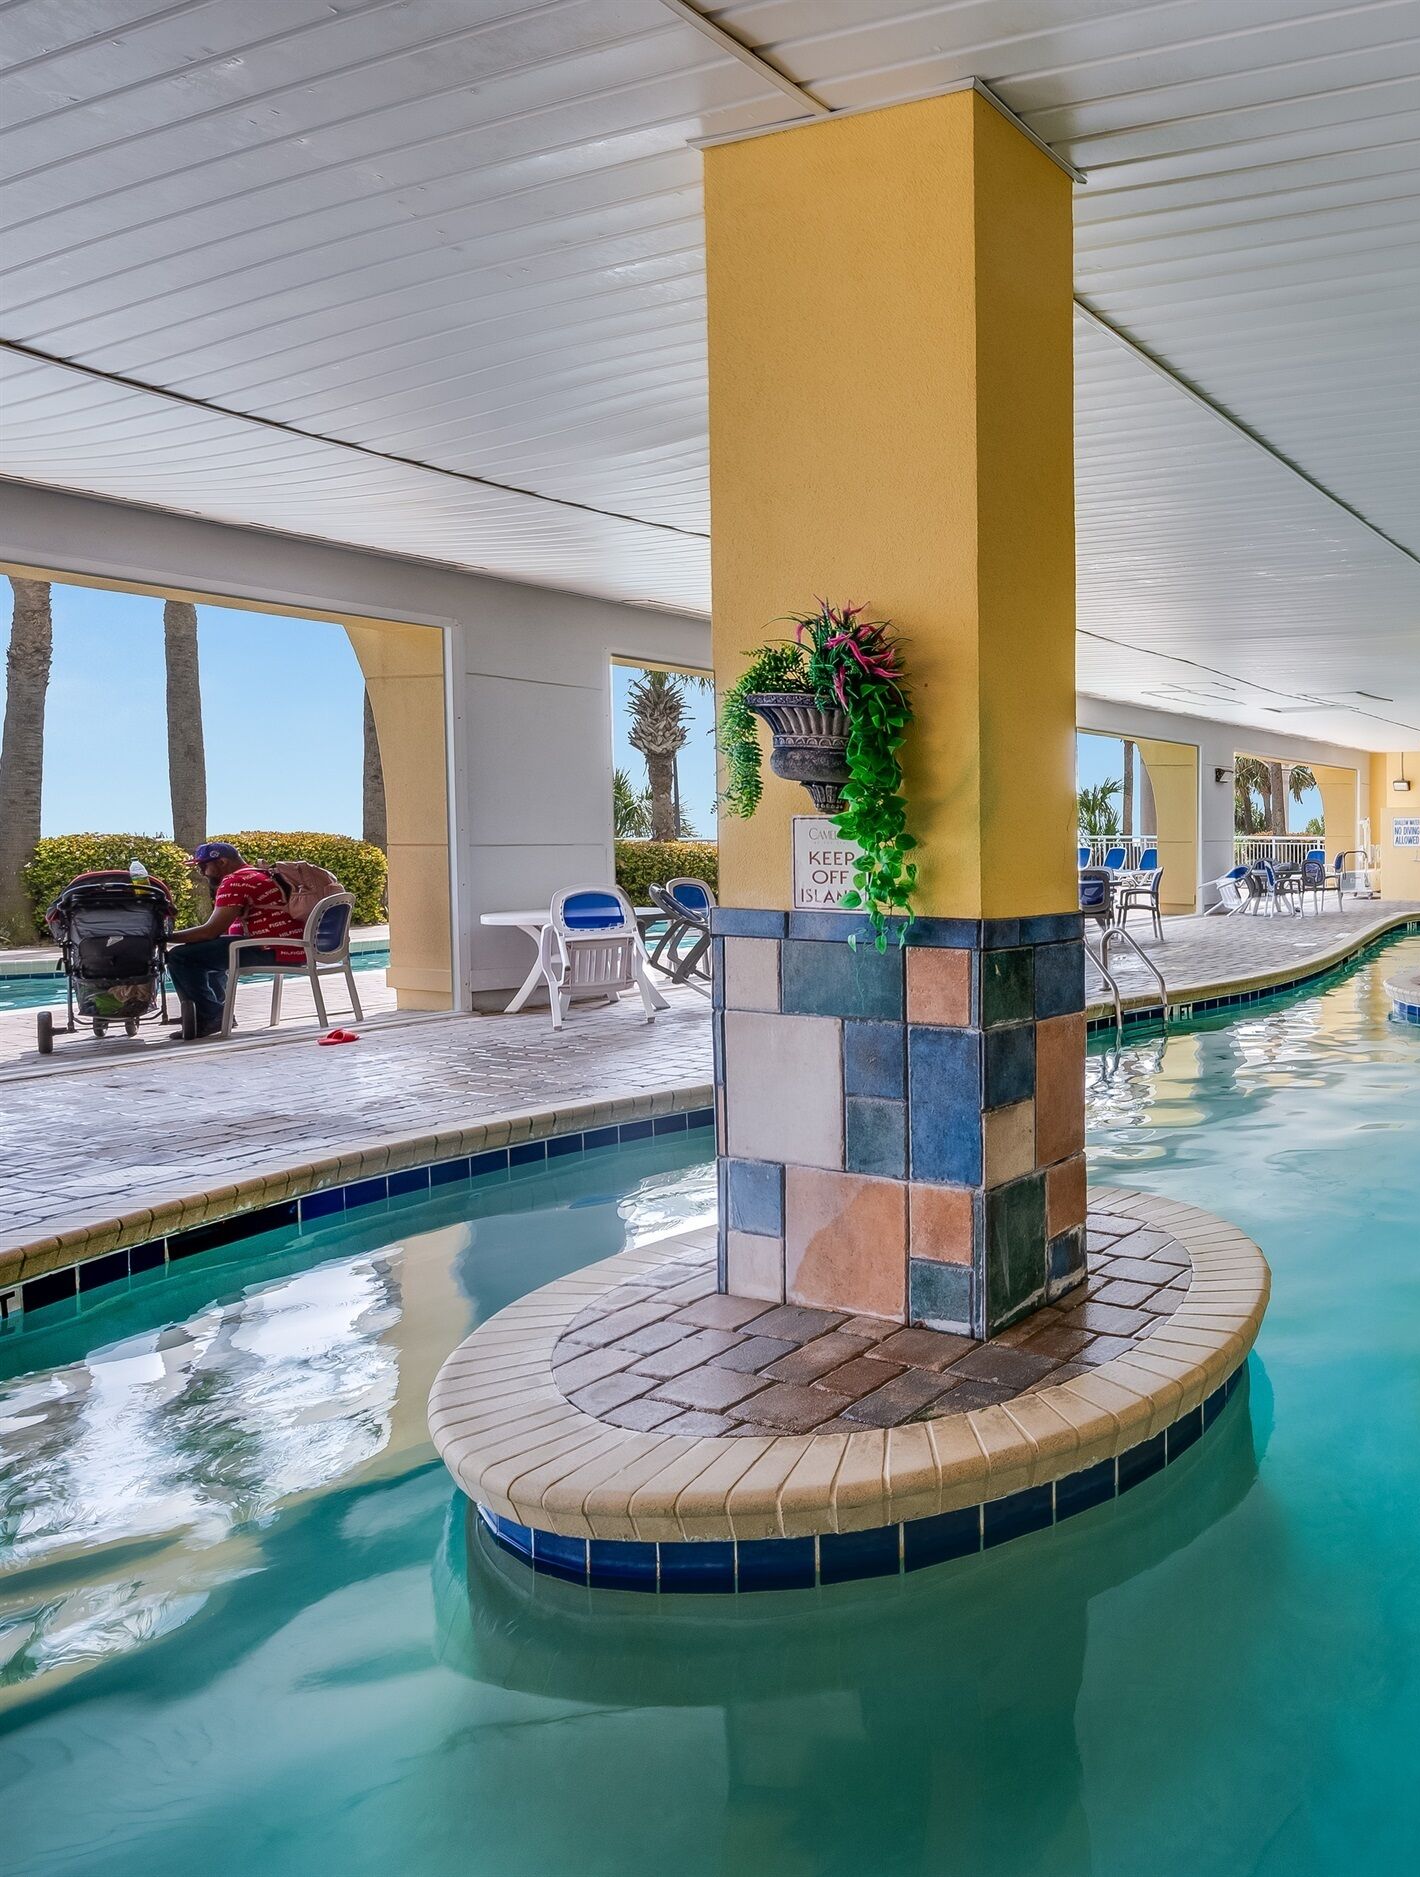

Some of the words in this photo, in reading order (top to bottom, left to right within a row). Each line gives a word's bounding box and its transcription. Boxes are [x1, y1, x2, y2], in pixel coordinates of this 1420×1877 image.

[1394, 827, 1403, 835] NO
[1403, 827, 1420, 835] DIVING
[1394, 836, 1420, 845] ALLOWED
[809, 851, 855, 866] KEEP
[812, 870, 850, 885] OFF
